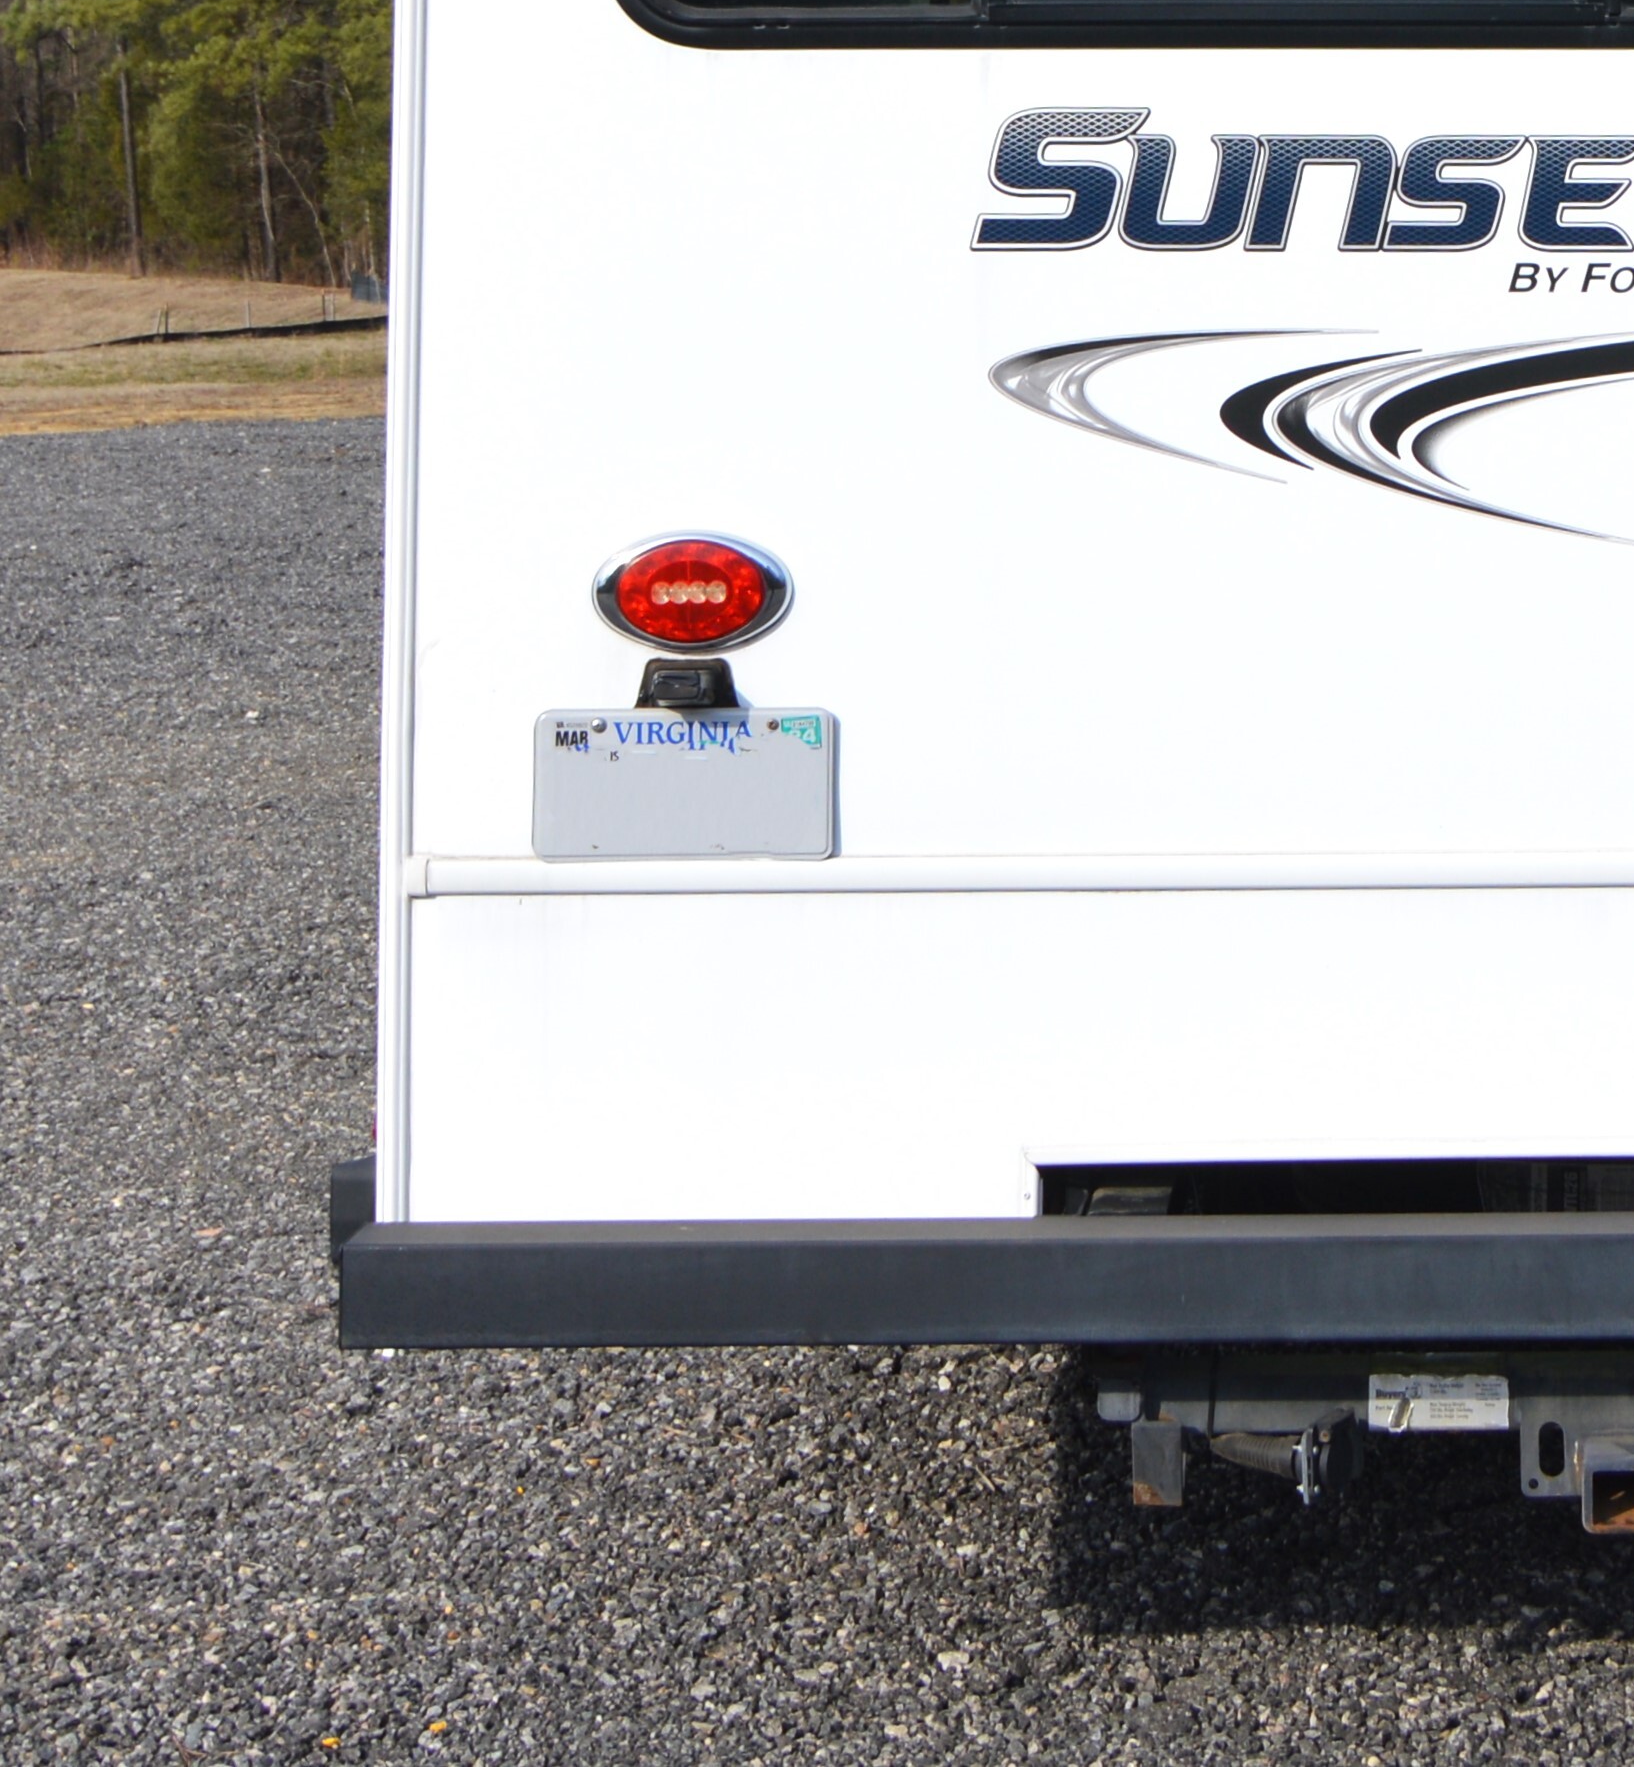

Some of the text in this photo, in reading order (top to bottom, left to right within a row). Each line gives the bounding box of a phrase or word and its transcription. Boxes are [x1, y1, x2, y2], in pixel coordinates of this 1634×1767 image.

[1508, 263, 1568, 293] BY
[555, 730, 588, 747] MAR
[613, 720, 751, 750] VIRGINIA
